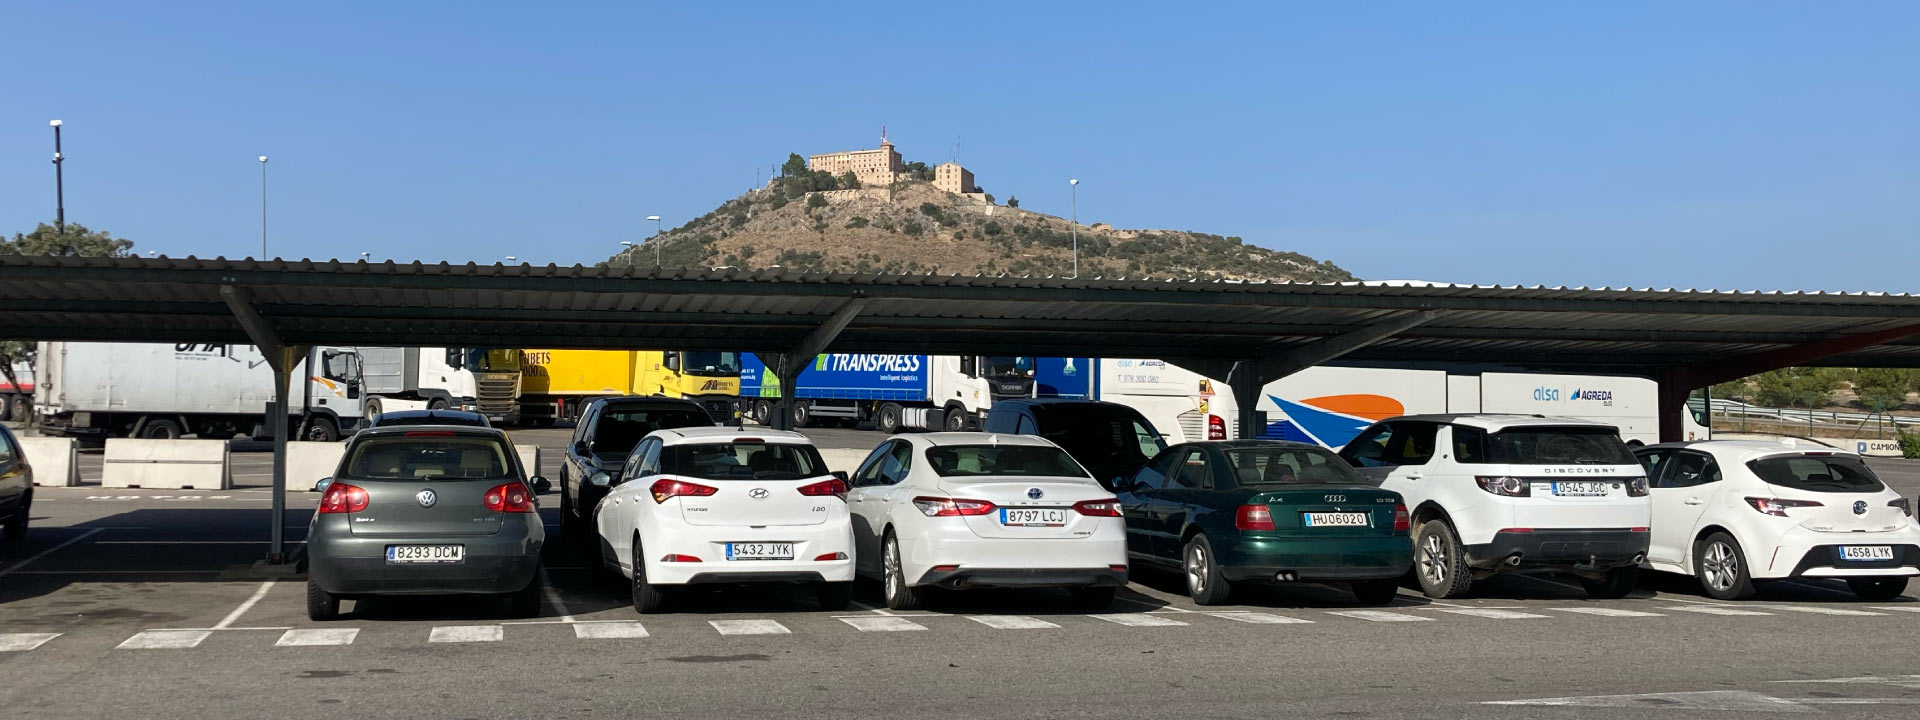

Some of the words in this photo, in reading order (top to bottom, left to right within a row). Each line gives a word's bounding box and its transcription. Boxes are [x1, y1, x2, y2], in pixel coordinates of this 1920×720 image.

[832, 354, 920, 372] TRANSPRESS
[879, 374, 900, 383] Intelligent
[901, 374, 919, 383] logistics
[1533, 386, 1559, 401] alsa
[1581, 390, 1613, 401] AGREDA
[1559, 482, 1585, 493] 0545
[1588, 482, 1605, 493] JGC
[1009, 511, 1039, 522] 8797
[1042, 511, 1064, 522] LCJ
[397, 547, 431, 558] 8293
[434, 547, 459, 558] DCM
[734, 544, 764, 555] 5432
[768, 544, 790, 555] JYK
[1847, 548, 1870, 557] 4658
[1873, 548, 1891, 557] LYK
